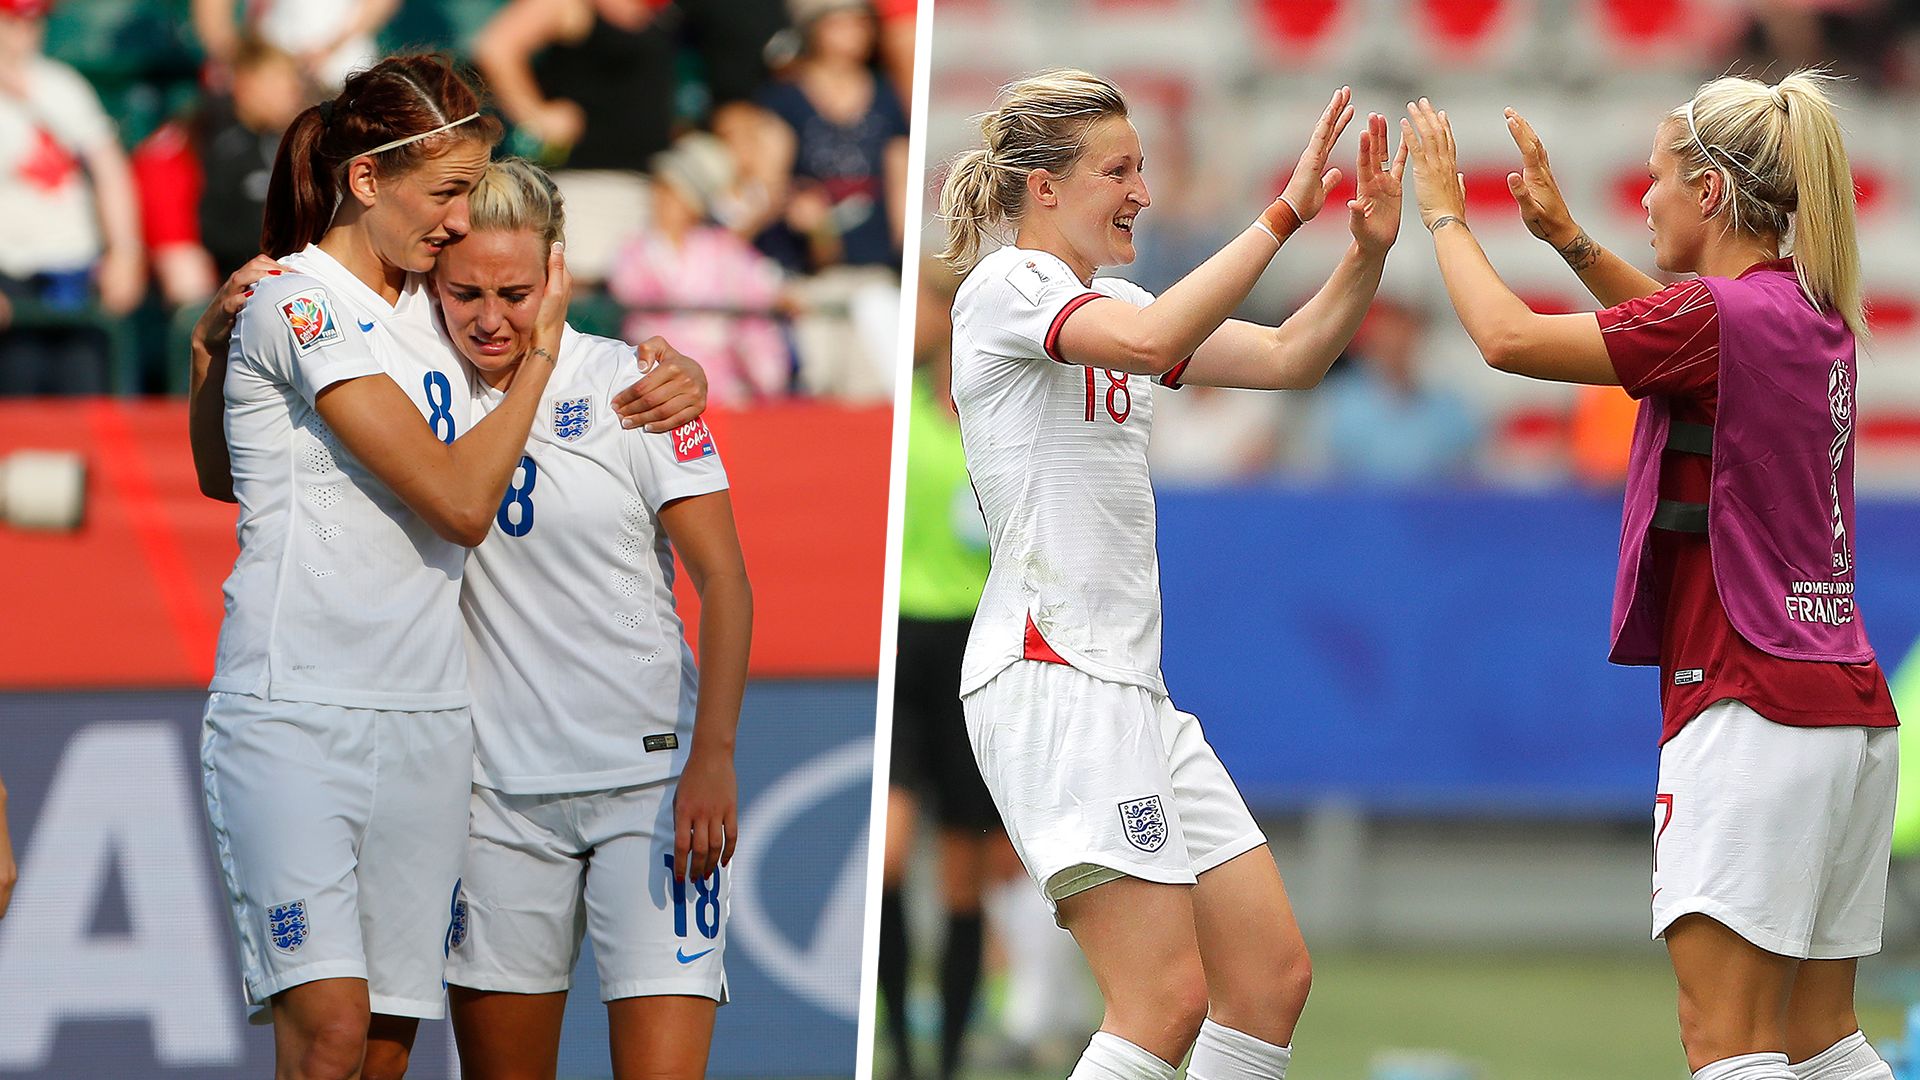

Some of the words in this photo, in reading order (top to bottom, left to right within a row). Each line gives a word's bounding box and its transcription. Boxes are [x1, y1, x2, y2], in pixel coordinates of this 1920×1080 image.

[423, 370, 456, 446] 8
[1084, 366, 1132, 424] 18
[678, 425, 709, 456] GOALS
[664, 853, 720, 939] 18
